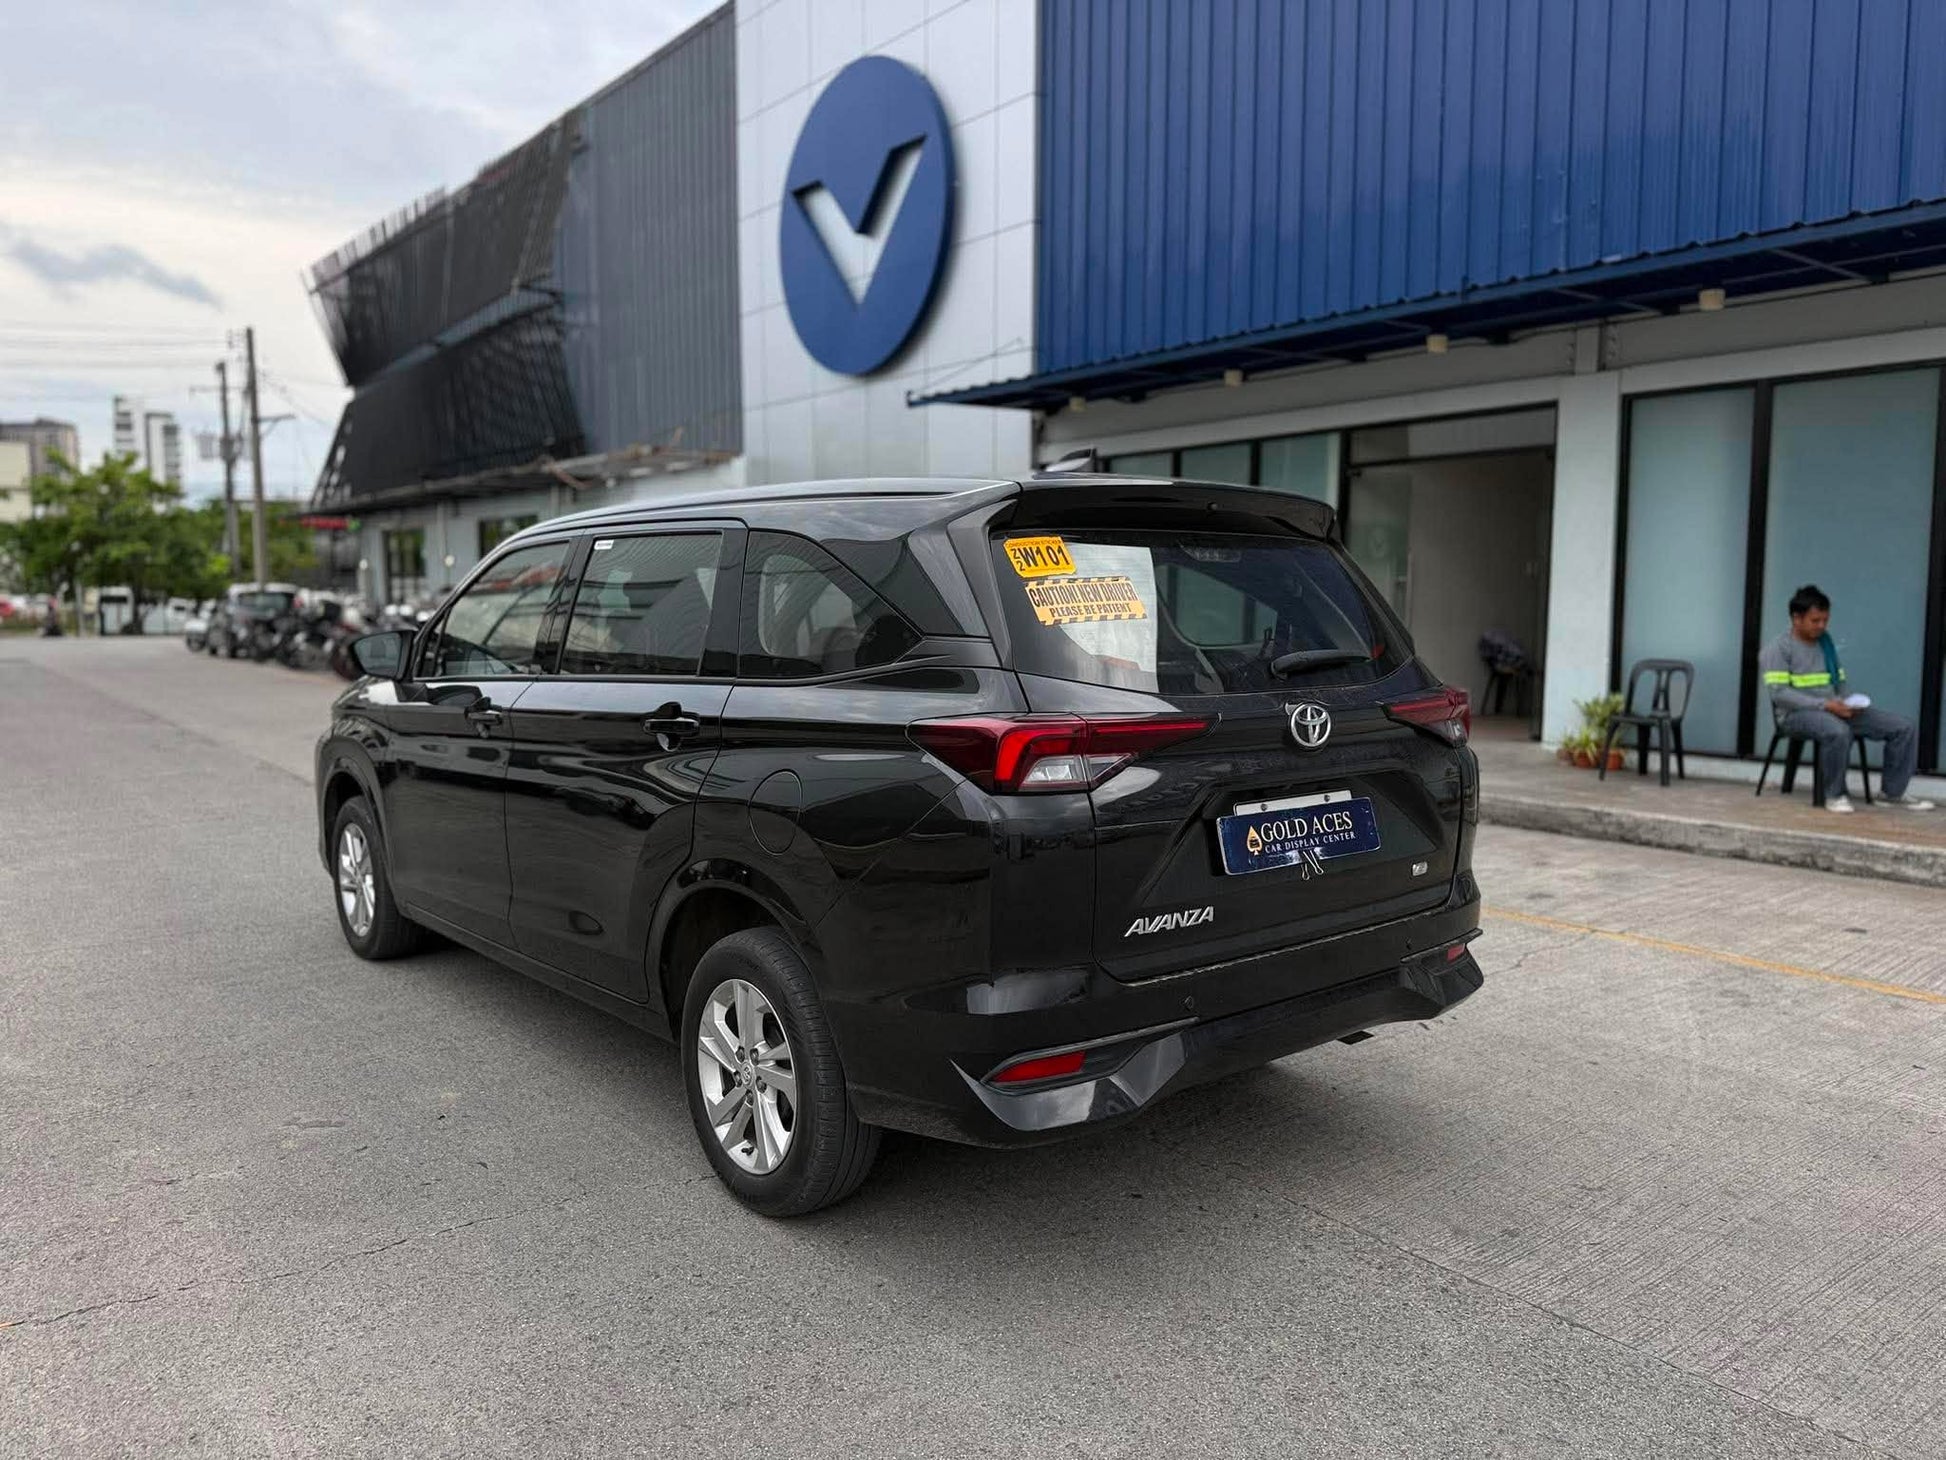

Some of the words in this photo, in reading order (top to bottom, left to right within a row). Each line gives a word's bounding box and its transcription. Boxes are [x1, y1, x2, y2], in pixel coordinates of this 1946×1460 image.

[1029, 585, 1080, 607] CAUTION!
[1078, 583, 1102, 603] NEW
[1100, 582, 1139, 602] DRIVER
[1049, 606, 1084, 618] PLEASE
[1084, 605, 1097, 614] BE
[1096, 603, 1131, 614] PATIENT
[1261, 818, 1308, 842] GOLD
[1312, 811, 1353, 834] ACES
[1265, 843, 1284, 854] CAR
[1285, 837, 1320, 850] DISPLAY
[1323, 832, 1356, 844] CENTER
[1124, 906, 1214, 937] AVANZA
